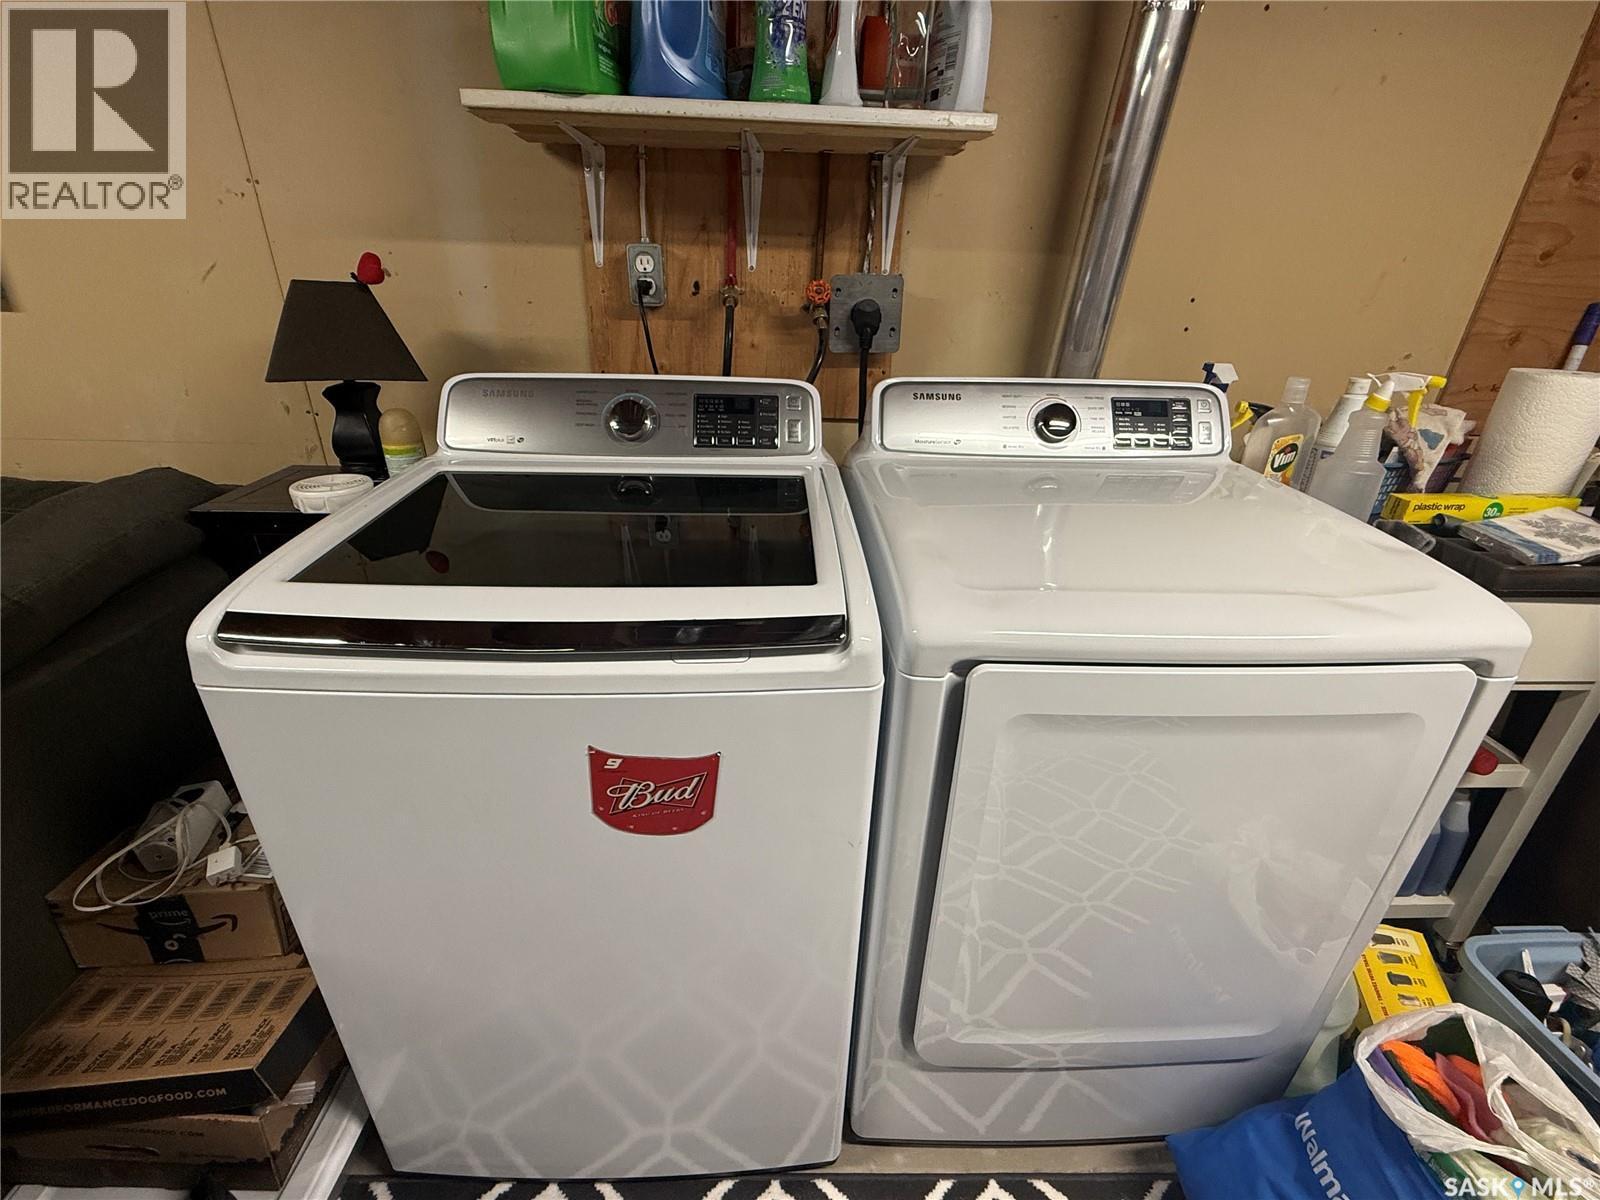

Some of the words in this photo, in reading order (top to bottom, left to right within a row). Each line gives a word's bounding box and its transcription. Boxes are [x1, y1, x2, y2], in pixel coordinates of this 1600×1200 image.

[482, 389, 535, 398] SAMSUNG
[912, 392, 962, 401] SAMSUNG
[1273, 450, 1297, 468] Vim
[1412, 502, 1443, 512] plastic
[1443, 503, 1466, 512] wrap
[603, 758, 623, 769] 9
[607, 777, 699, 810] Bud
